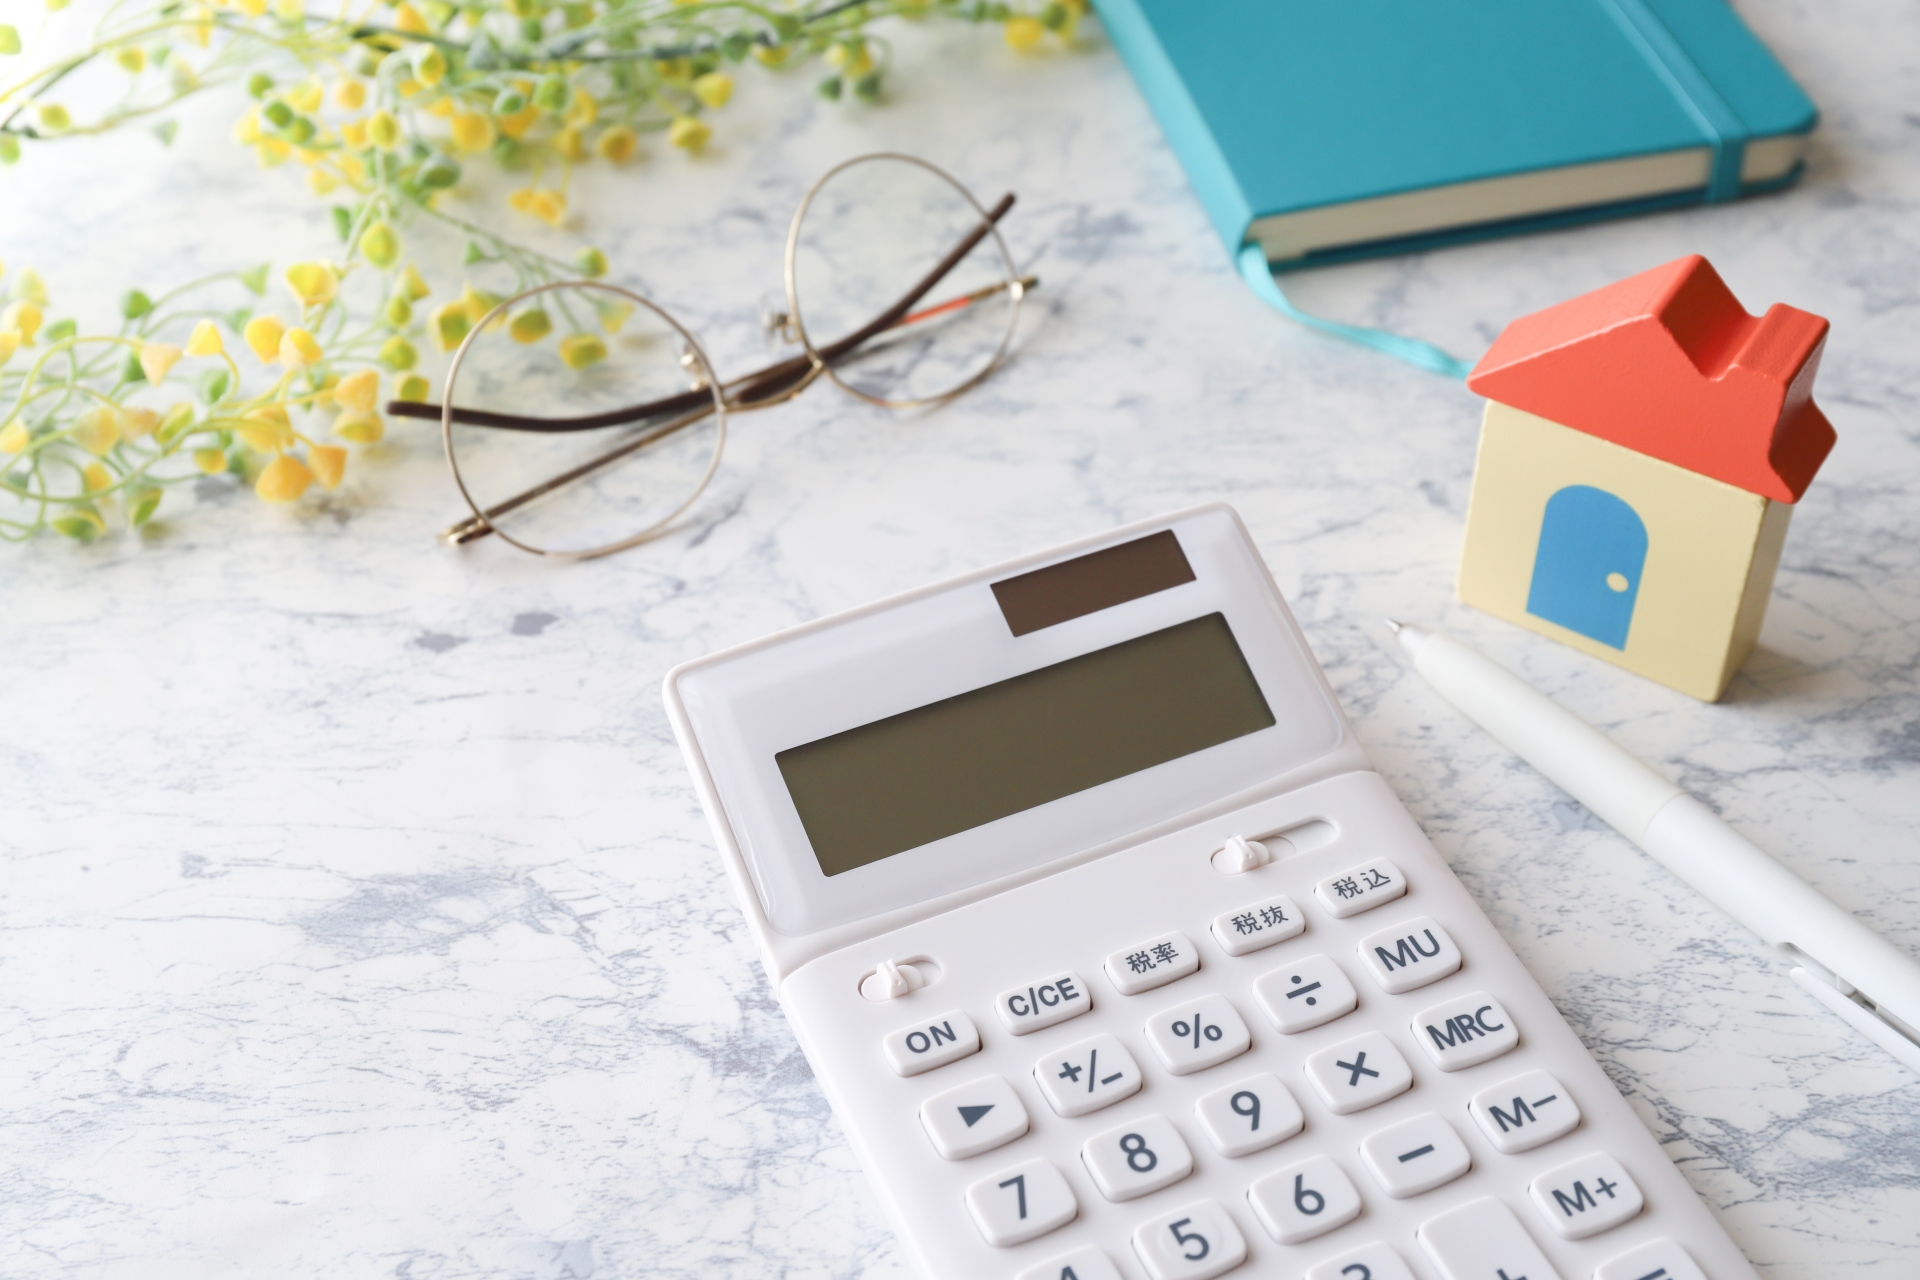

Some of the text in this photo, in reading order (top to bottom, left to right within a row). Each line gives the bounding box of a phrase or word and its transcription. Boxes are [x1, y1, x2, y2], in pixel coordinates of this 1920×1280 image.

[1332, 869, 1390, 899] 税込
[1231, 906, 1288, 935] 税抜
[1126, 942, 1179, 974] 税率
[1375, 929, 1440, 971] MU
[1008, 978, 1079, 1016] C/CE
[906, 1021, 956, 1053] ON
[1172, 1013, 1222, 1049] %
[1426, 1006, 1504, 1050] MRC
[1231, 1091, 1260, 1131] 9
[1120, 1133, 1157, 1172] 8
[999, 1175, 1027, 1219] 7
[1295, 1174, 1325, 1215] 6
[1552, 1178, 1617, 1216] M+
[1169, 1218, 1209, 1261] 5
